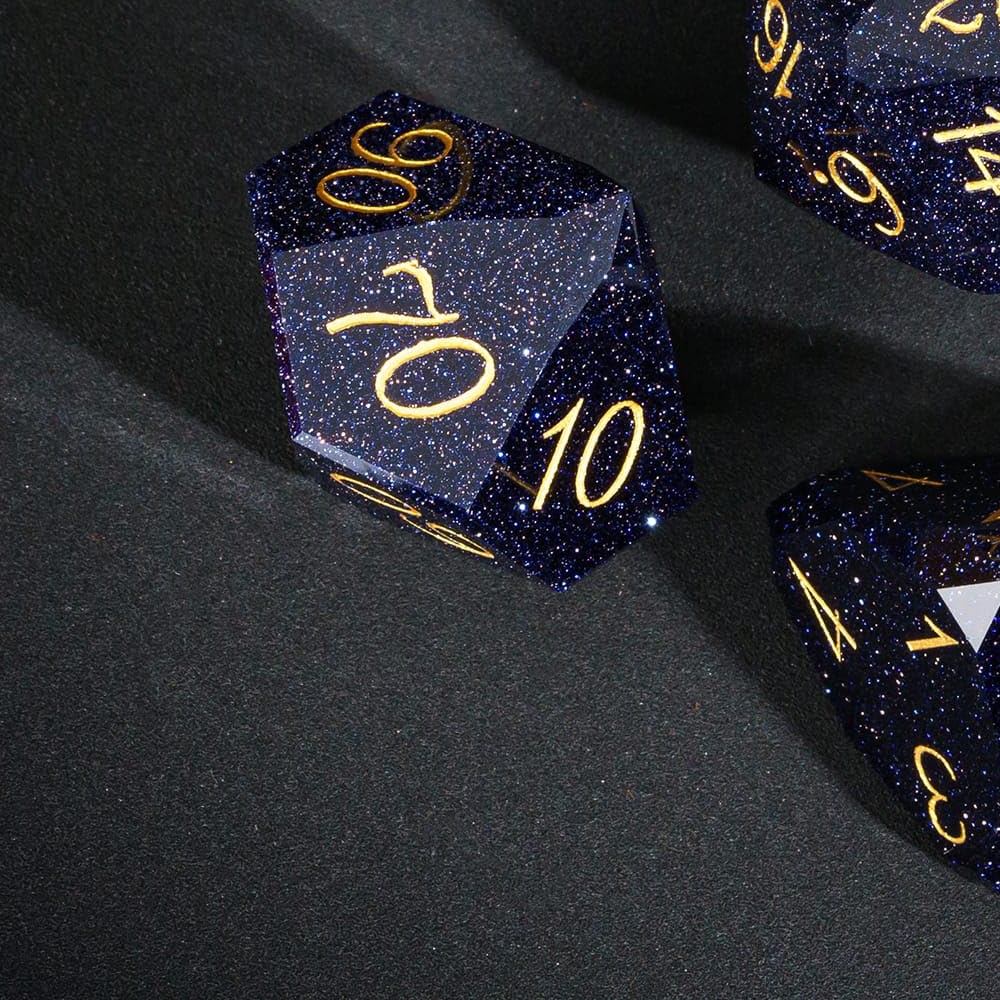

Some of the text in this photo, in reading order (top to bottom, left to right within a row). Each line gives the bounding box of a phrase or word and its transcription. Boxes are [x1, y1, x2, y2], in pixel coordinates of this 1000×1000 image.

[326, 259, 496, 420] 70
[533, 398, 647, 511] 10
[788, 557, 858, 663] 4
[905, 615, 960, 653] 1
[912, 744, 968, 846] 3
